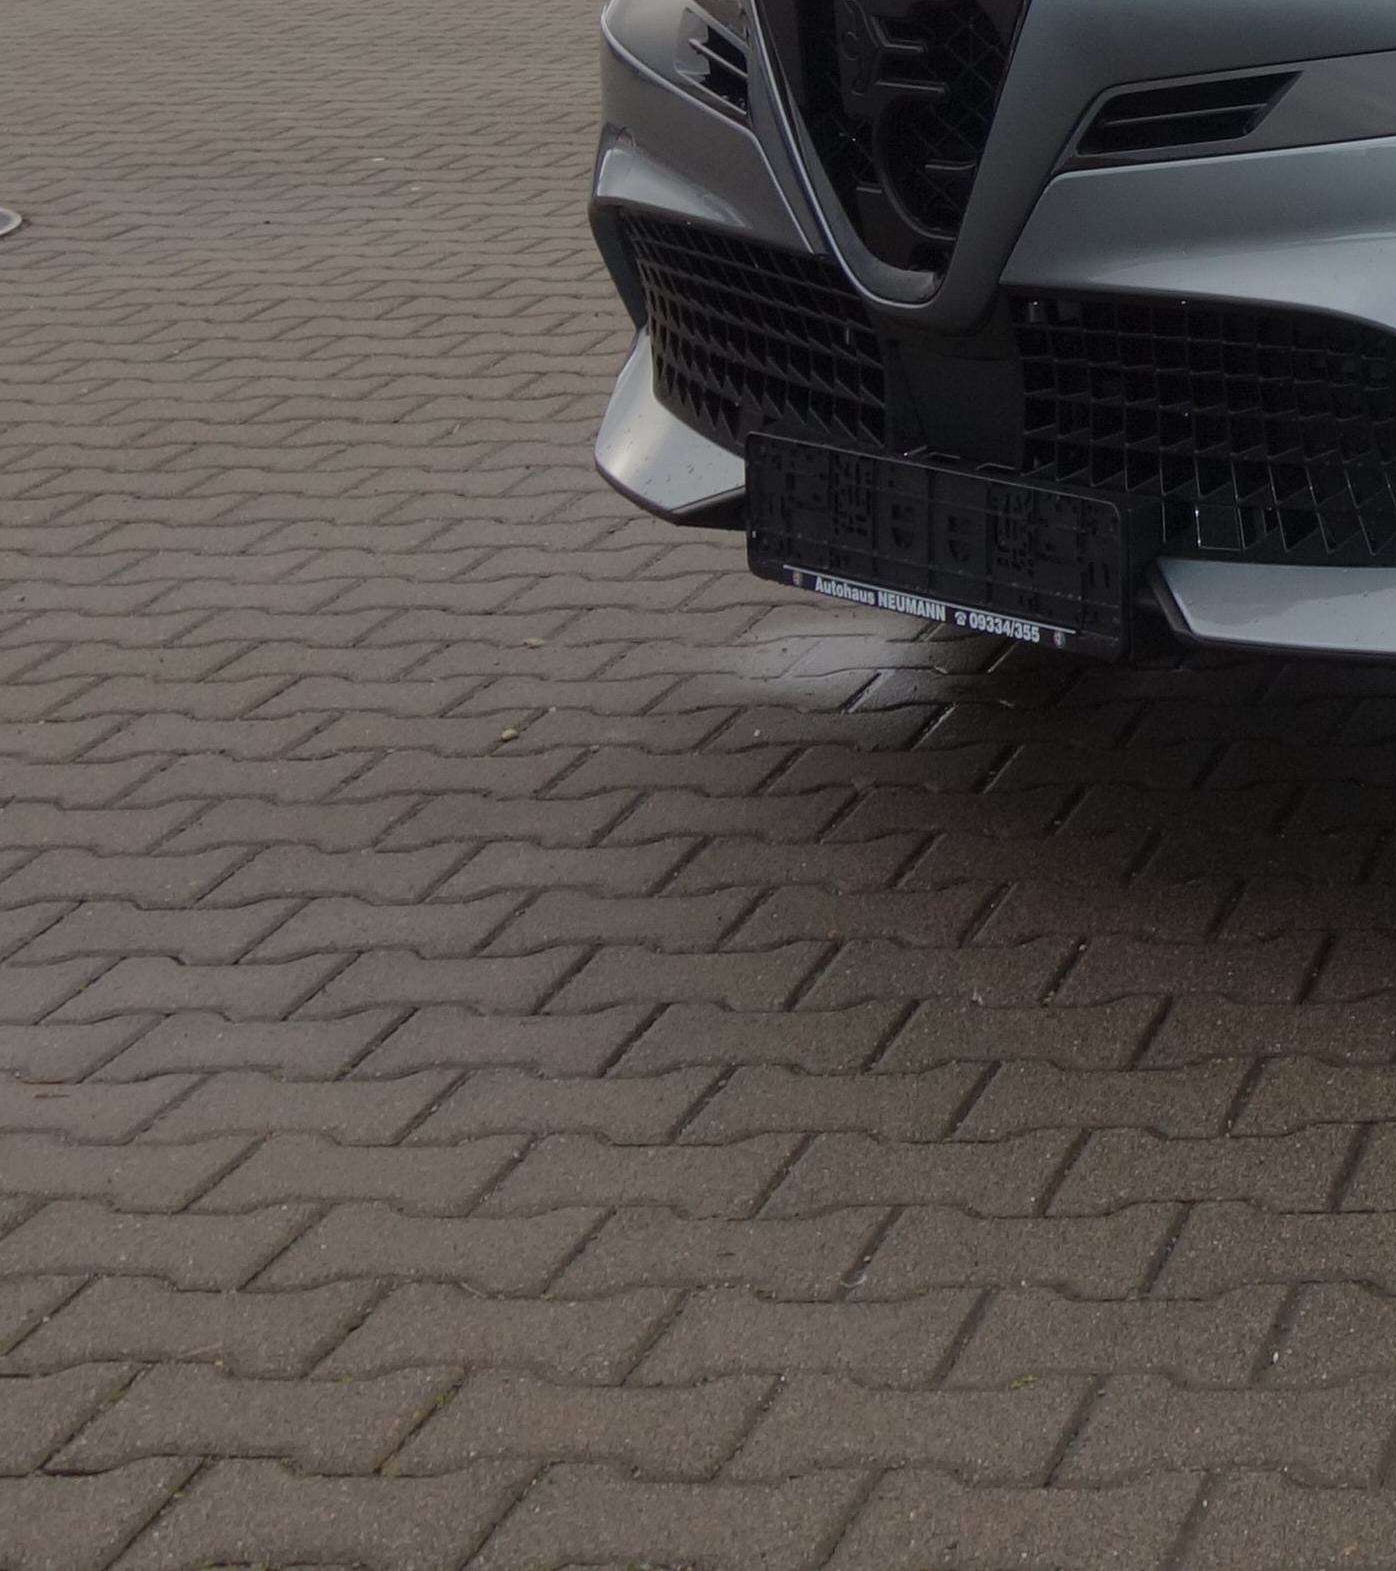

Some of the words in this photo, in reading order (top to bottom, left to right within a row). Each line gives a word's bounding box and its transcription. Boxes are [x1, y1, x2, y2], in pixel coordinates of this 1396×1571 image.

[815, 576, 876, 607] Autohaus
[878, 591, 946, 622] NEUMANN
[969, 612, 1041, 644] 09334/355
